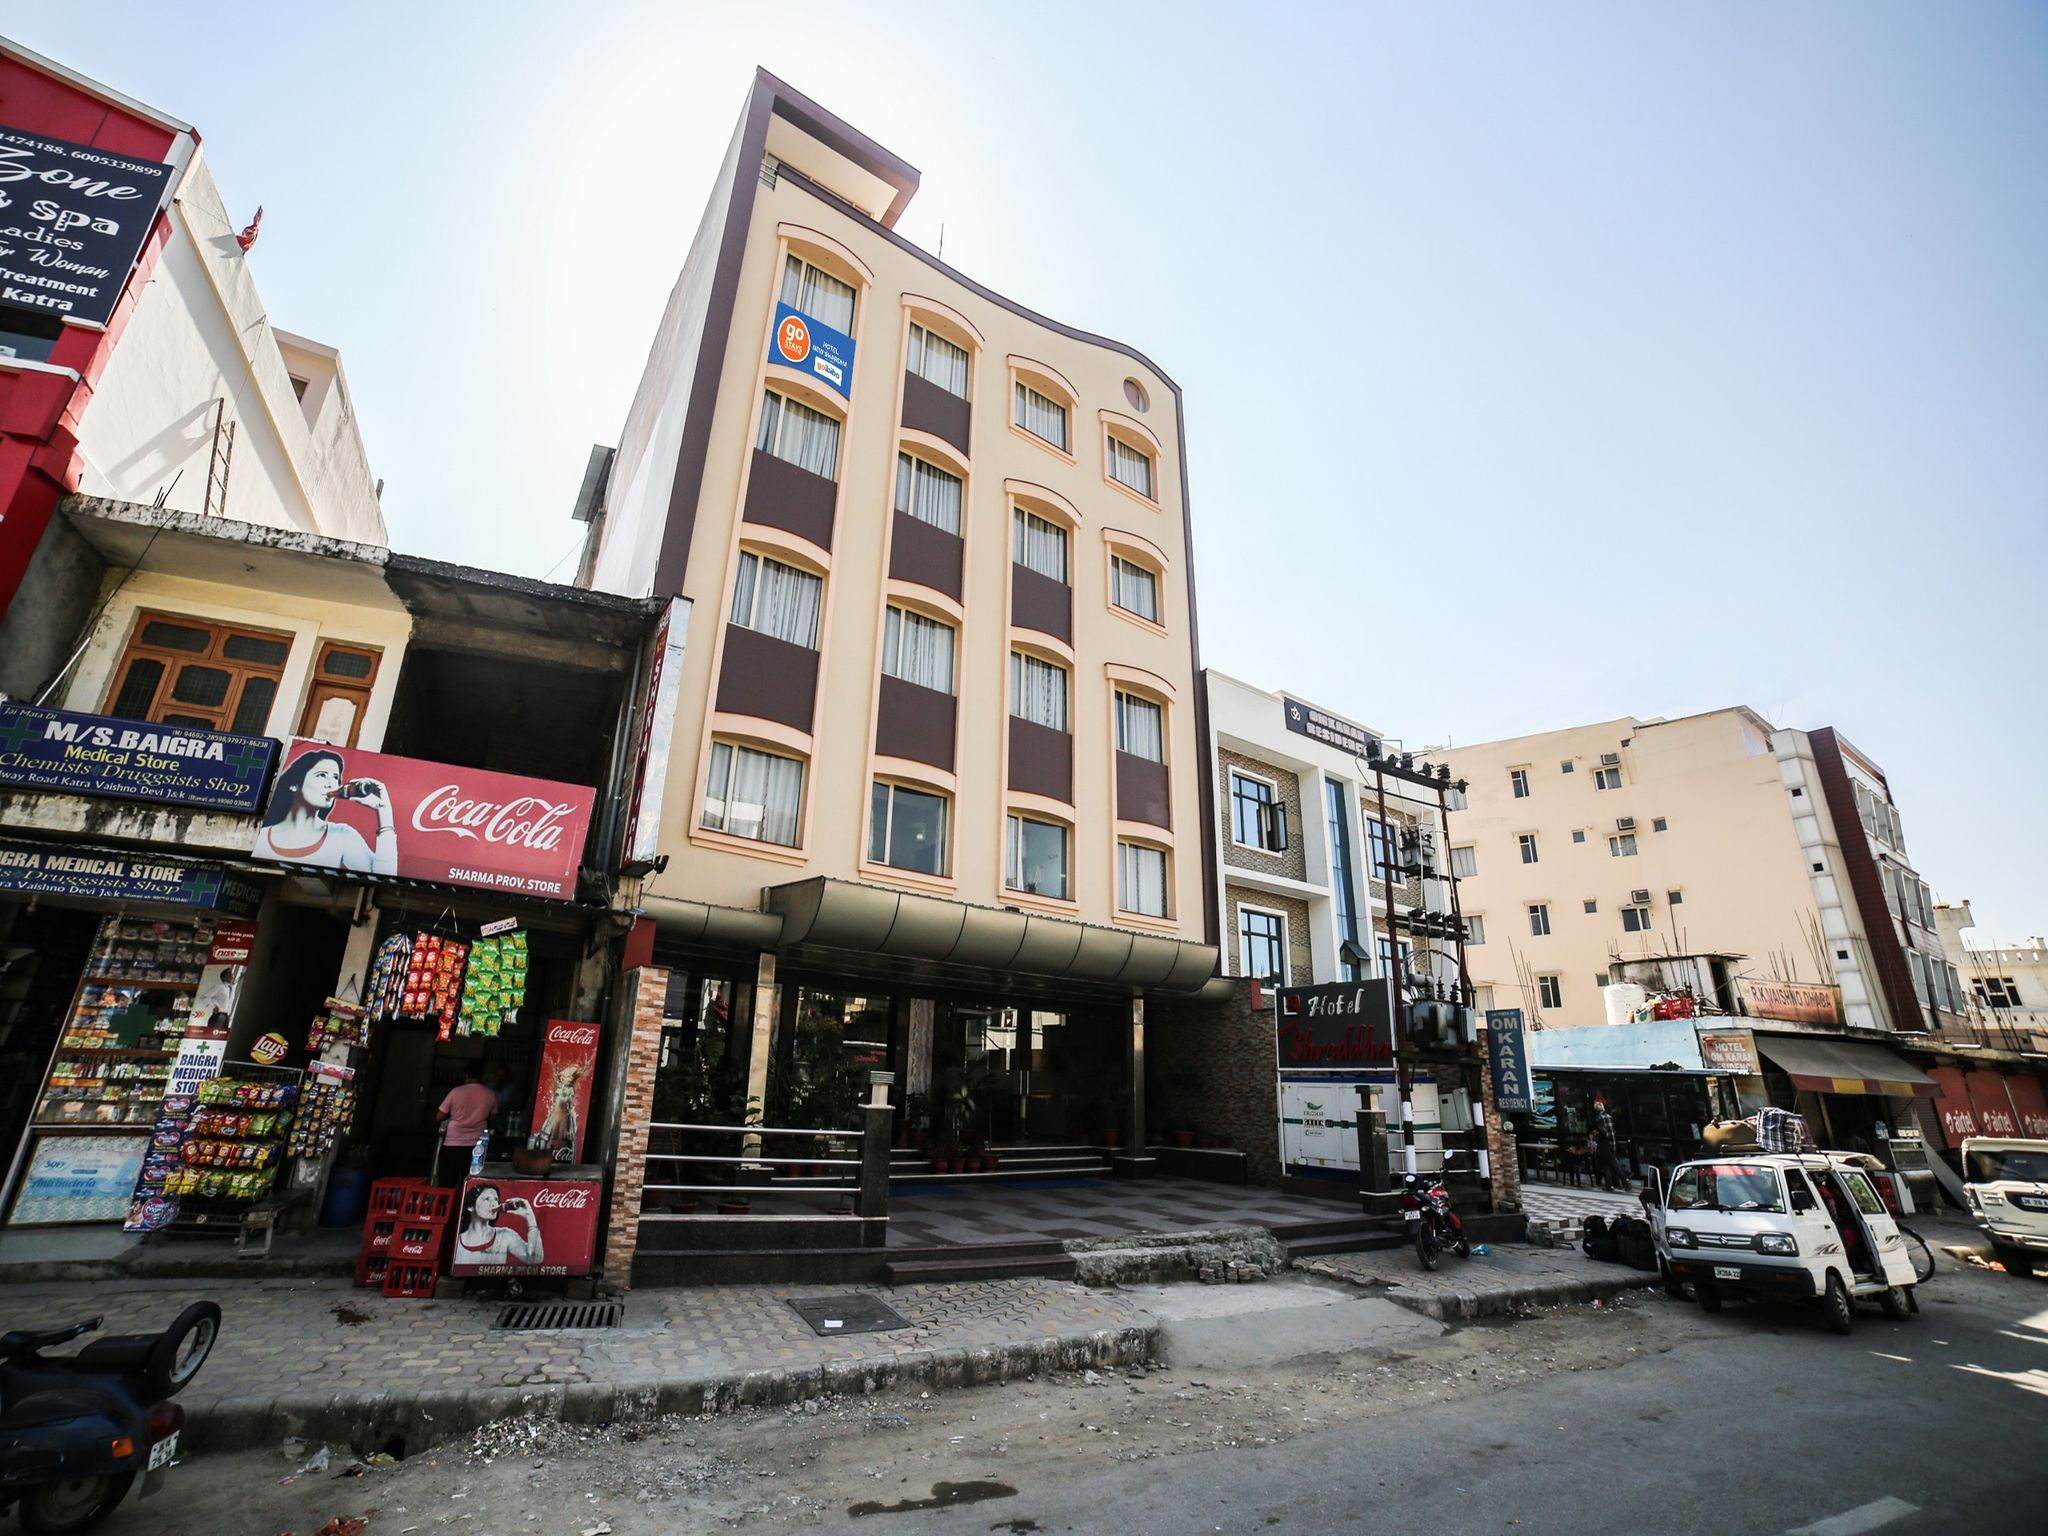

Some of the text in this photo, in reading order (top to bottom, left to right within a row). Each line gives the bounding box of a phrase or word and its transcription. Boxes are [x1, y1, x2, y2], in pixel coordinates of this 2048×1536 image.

[70, 150, 162, 178] 6005339899
[28, 199, 119, 236] Spa
[0, 226, 84, 250] adies
[27, 248, 110, 279] Woman
[2, 286, 73, 311] Katra
[64, 744, 180, 772] Medical Store
[28, 772, 57, 785] Road
[60, 776, 91, 789] Katra
[95, 780, 137, 794] Vaishno
[204, 776, 250, 797] Shop
[412, 784, 577, 851] Coca-Cola
[45, 855, 124, 877] MEDICAL
[129, 863, 186, 883] STORE
[448, 867, 561, 894] SHARMA PROV. STORE
[1307, 988, 1366, 1017] Hotel
[1491, 1016, 1518, 1030] OM
[549, 1025, 596, 1046] Coca-Cola
[1715, 1042, 1746, 1052] HOTEL
[180, 1054, 218, 1067] BAIGRA
[533, 1188, 592, 1209] Coca-Cola
[540, 1265, 568, 1276] STORE
